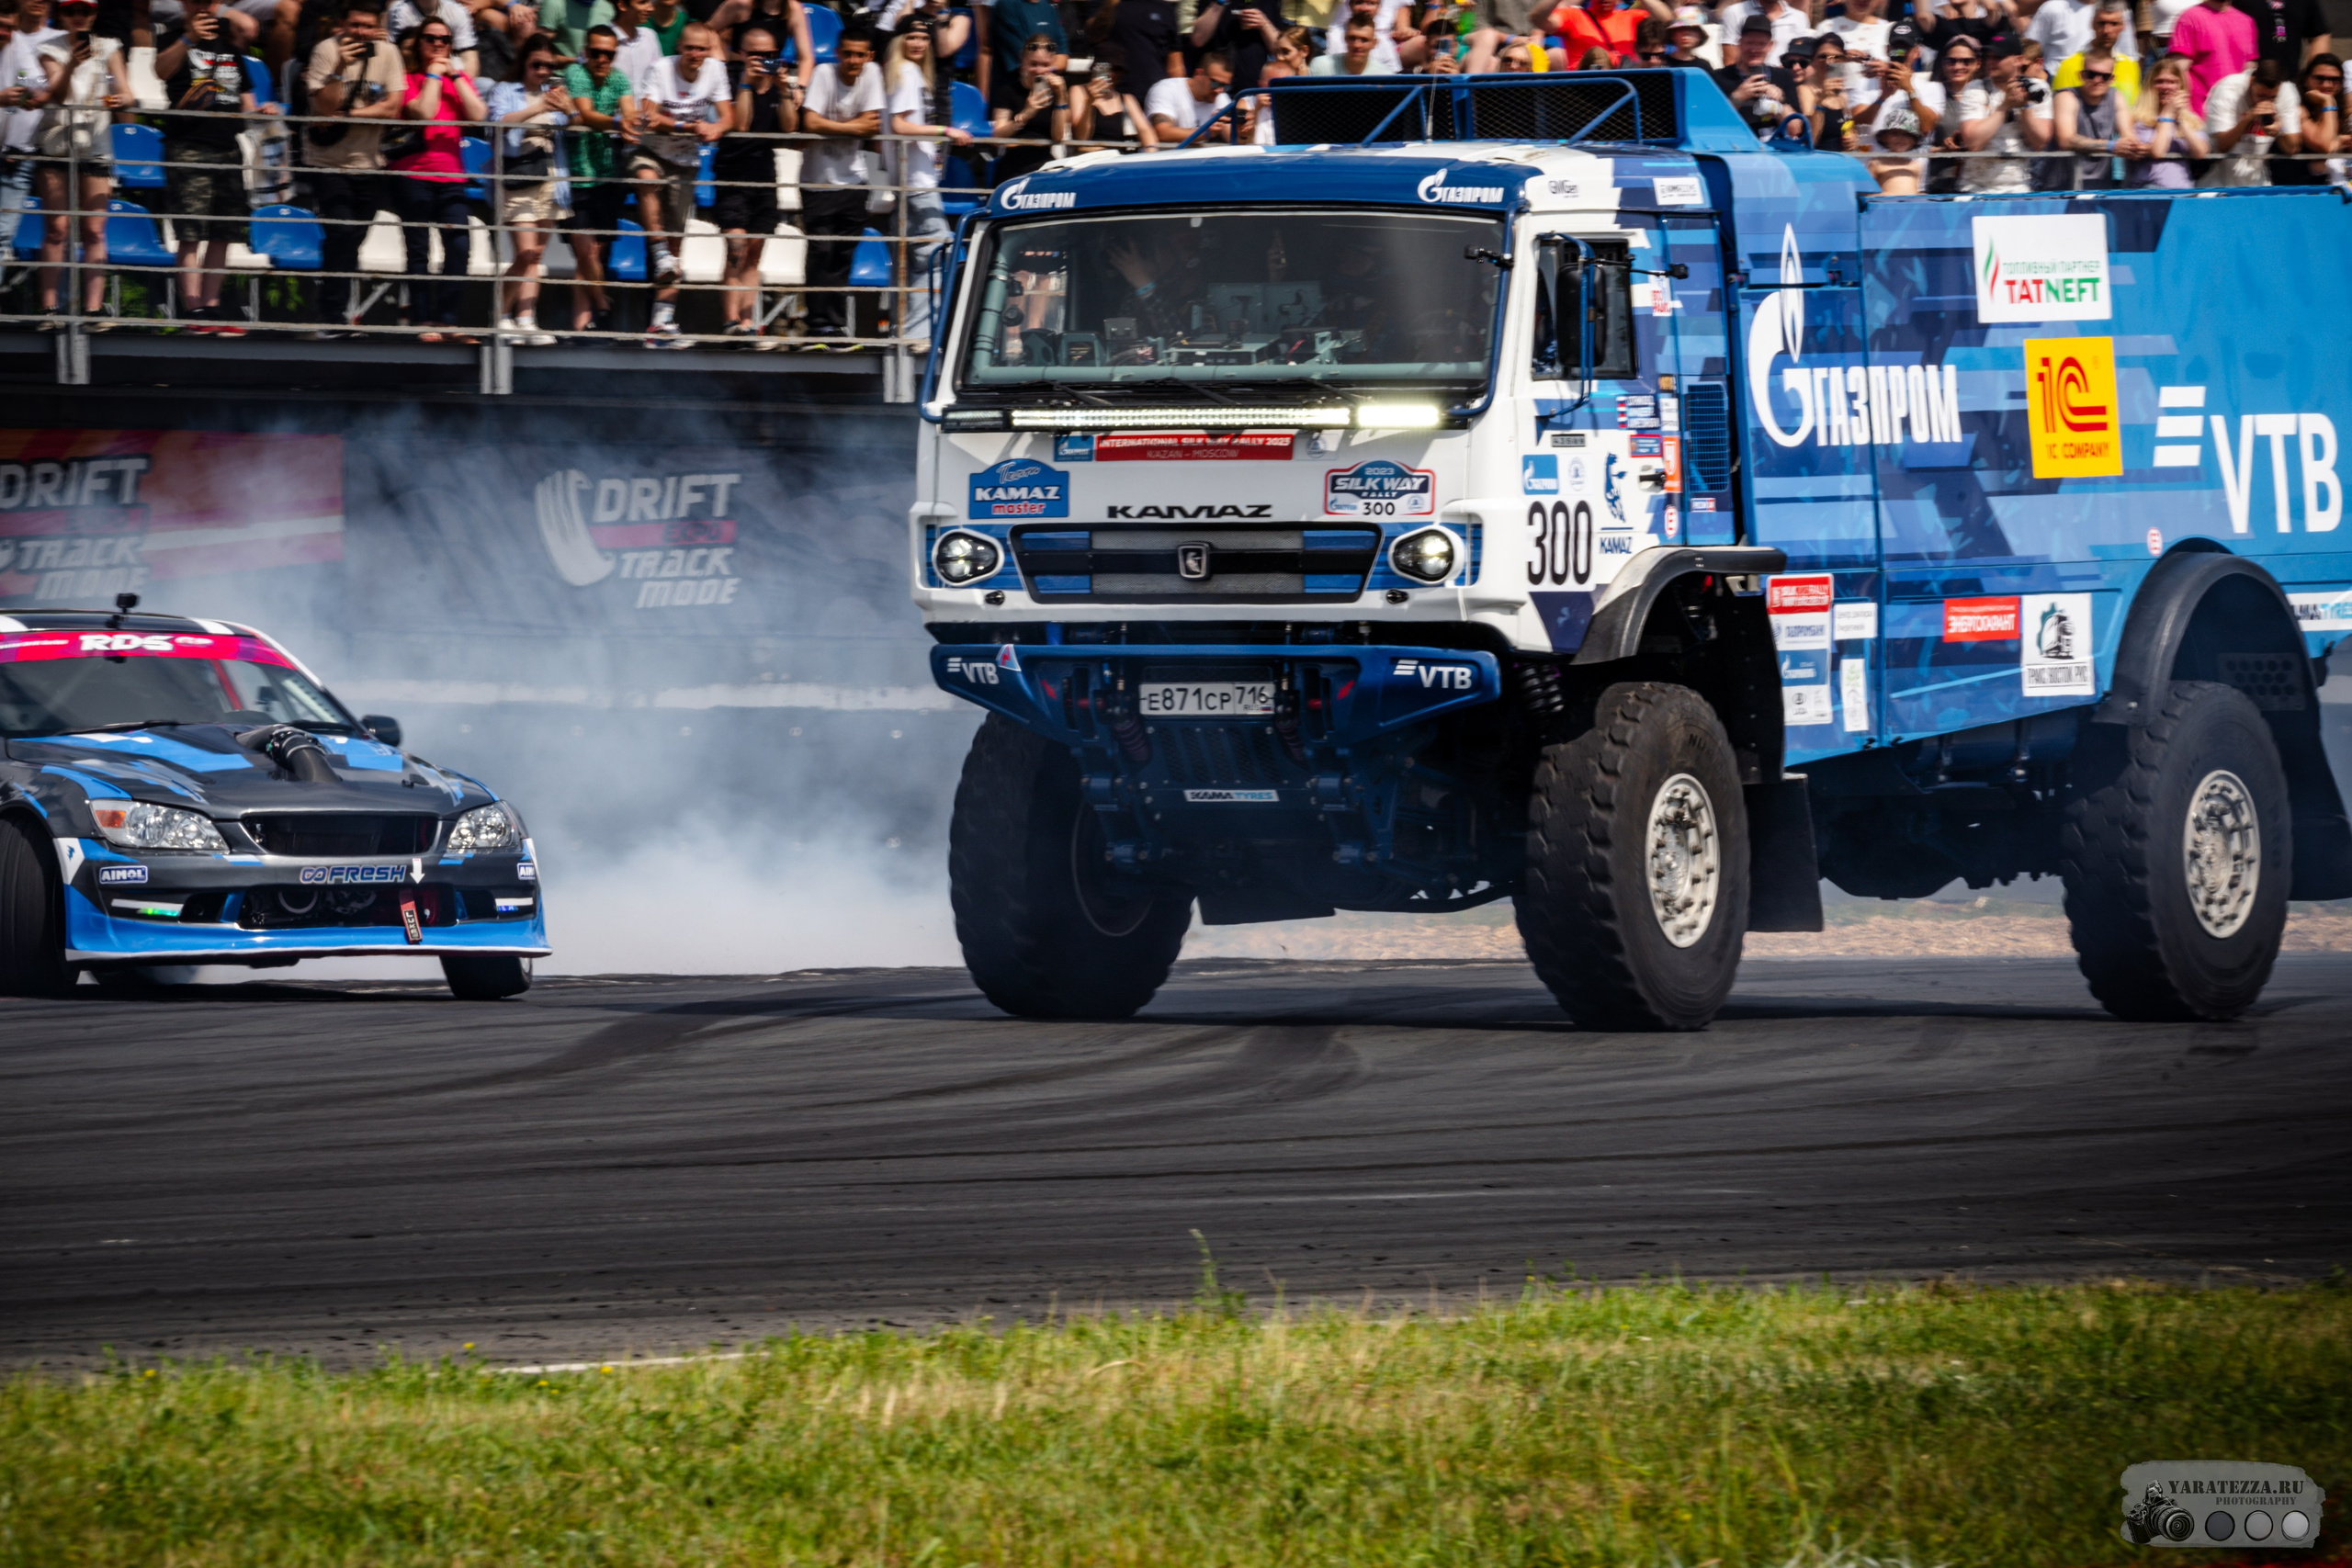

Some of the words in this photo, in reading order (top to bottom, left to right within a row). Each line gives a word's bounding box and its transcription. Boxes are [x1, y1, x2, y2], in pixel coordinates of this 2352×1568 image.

[1020, 192, 1076, 209] ГАЗПРОМ
[1441, 186, 1504, 203] ГАЗПРОМ
[2004, 277, 2100, 304] TATNEFT
[1813, 364, 1962, 447] ГАЗПРОМ
[1099, 437, 1179, 448] INTERNATIONAL
[2063, 442, 2110, 459] COMPANY
[1147, 448, 1183, 459] KAZAN
[1192, 448, 1239, 459] MOSCOW
[996, 461, 1041, 485] Team
[1364, 467, 1396, 476] 2023
[2210, 412, 2343, 534] VTB
[0, 458, 148, 509] DRIFT
[1334, 477, 1381, 491] SILK
[1382, 477, 1427, 491] WAY
[592, 473, 742, 523] DRIFT
[975, 485, 1061, 502] KAMAZ
[991, 501, 1046, 514] master
[1106, 504, 1272, 519] KAMAZ
[1363, 502, 1396, 515] 300
[1527, 500, 1593, 586] 300
[1600, 536, 1634, 555] KAMAZ
[634, 577, 742, 609] MODE
[1947, 613, 2016, 634] ЭНЕРГОГАРАНТ
[79, 634, 174, 651] RDS
[961, 662, 1001, 685] VTB
[1418, 665, 1473, 690] VTB
[1236, 685, 1270, 705] 716
[1235, 790, 1274, 800] TYRES
[100, 868, 146, 882] AIMOL
